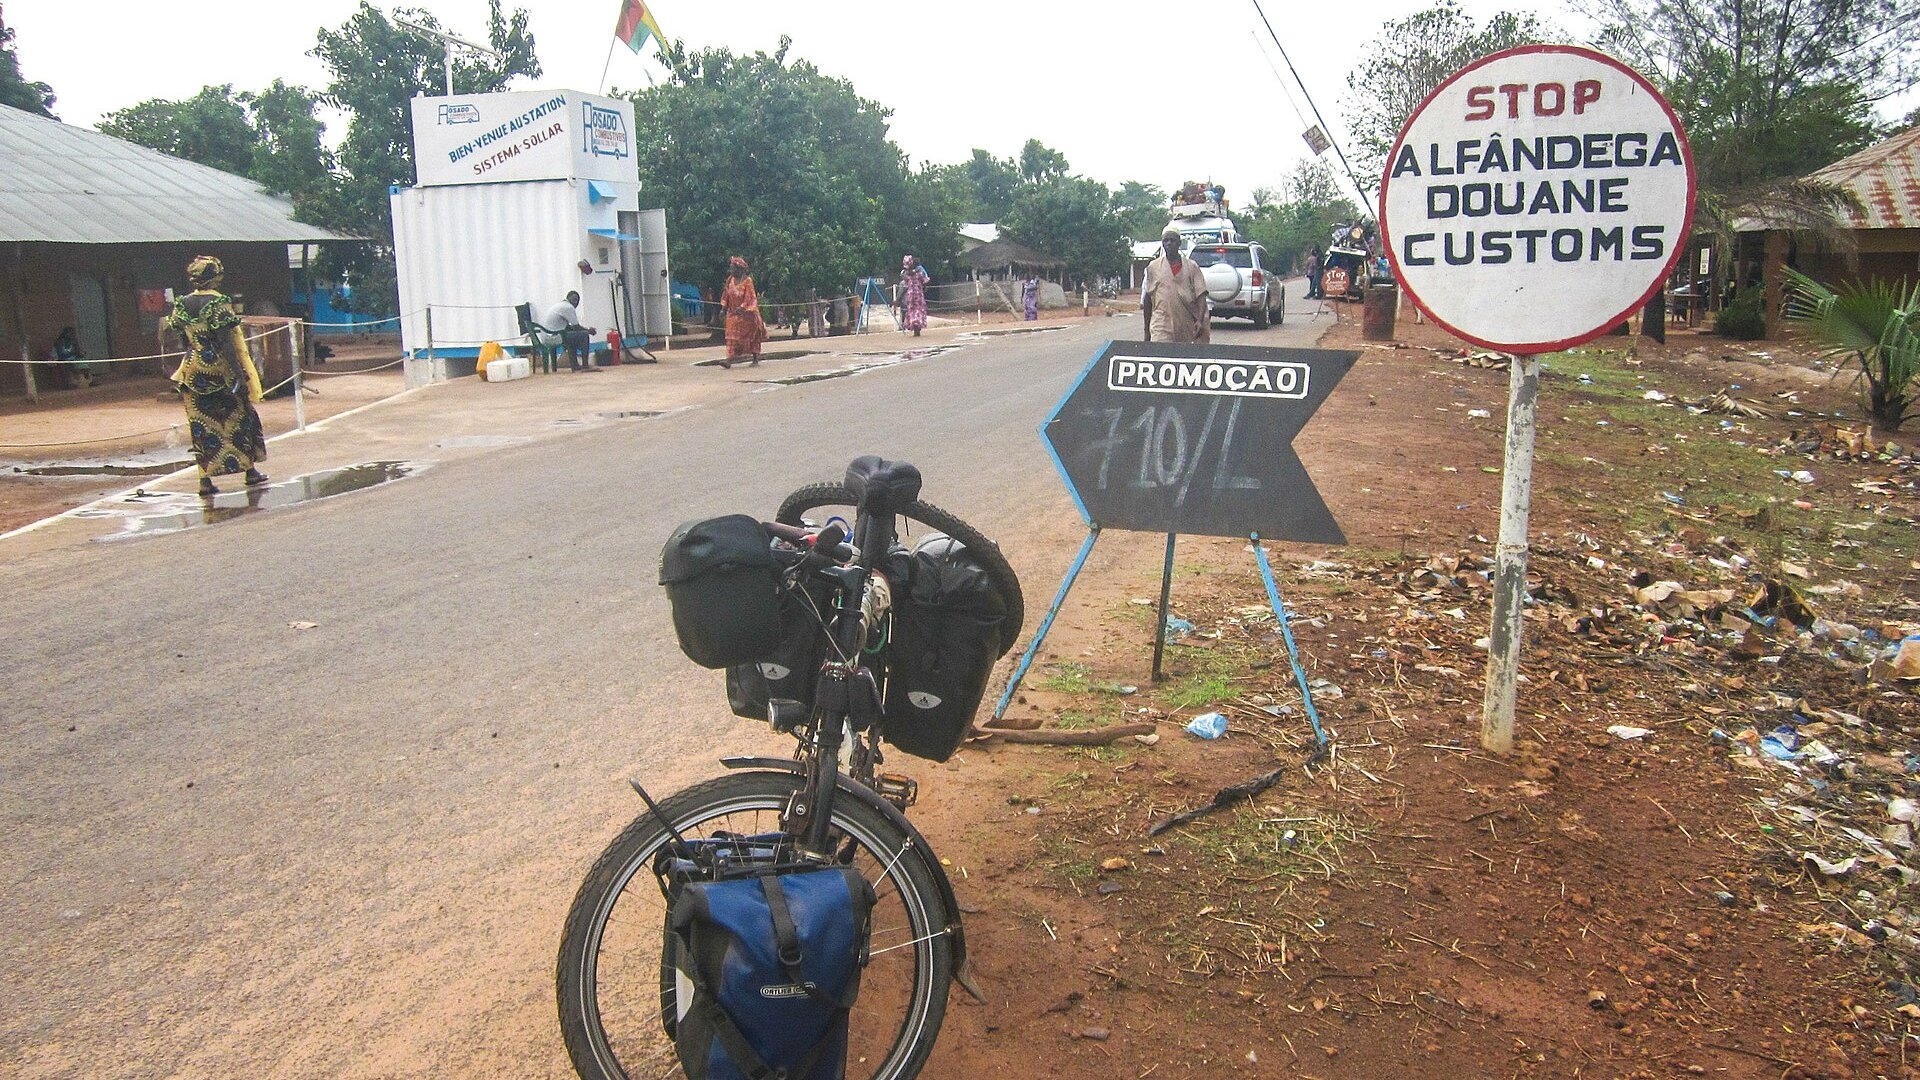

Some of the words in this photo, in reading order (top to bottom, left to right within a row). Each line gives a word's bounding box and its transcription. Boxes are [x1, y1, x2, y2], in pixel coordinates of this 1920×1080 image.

[1465, 79, 1601, 121] STOP
[448, 124, 508, 163] BIEN-VENUE
[1391, 132, 1682, 178] ALFÂNDEGA
[1427, 178, 1629, 219] DOUANE
[1404, 226, 1665, 266] CUSTOMS
[1117, 362, 1298, 392] PROMOÇÃO
